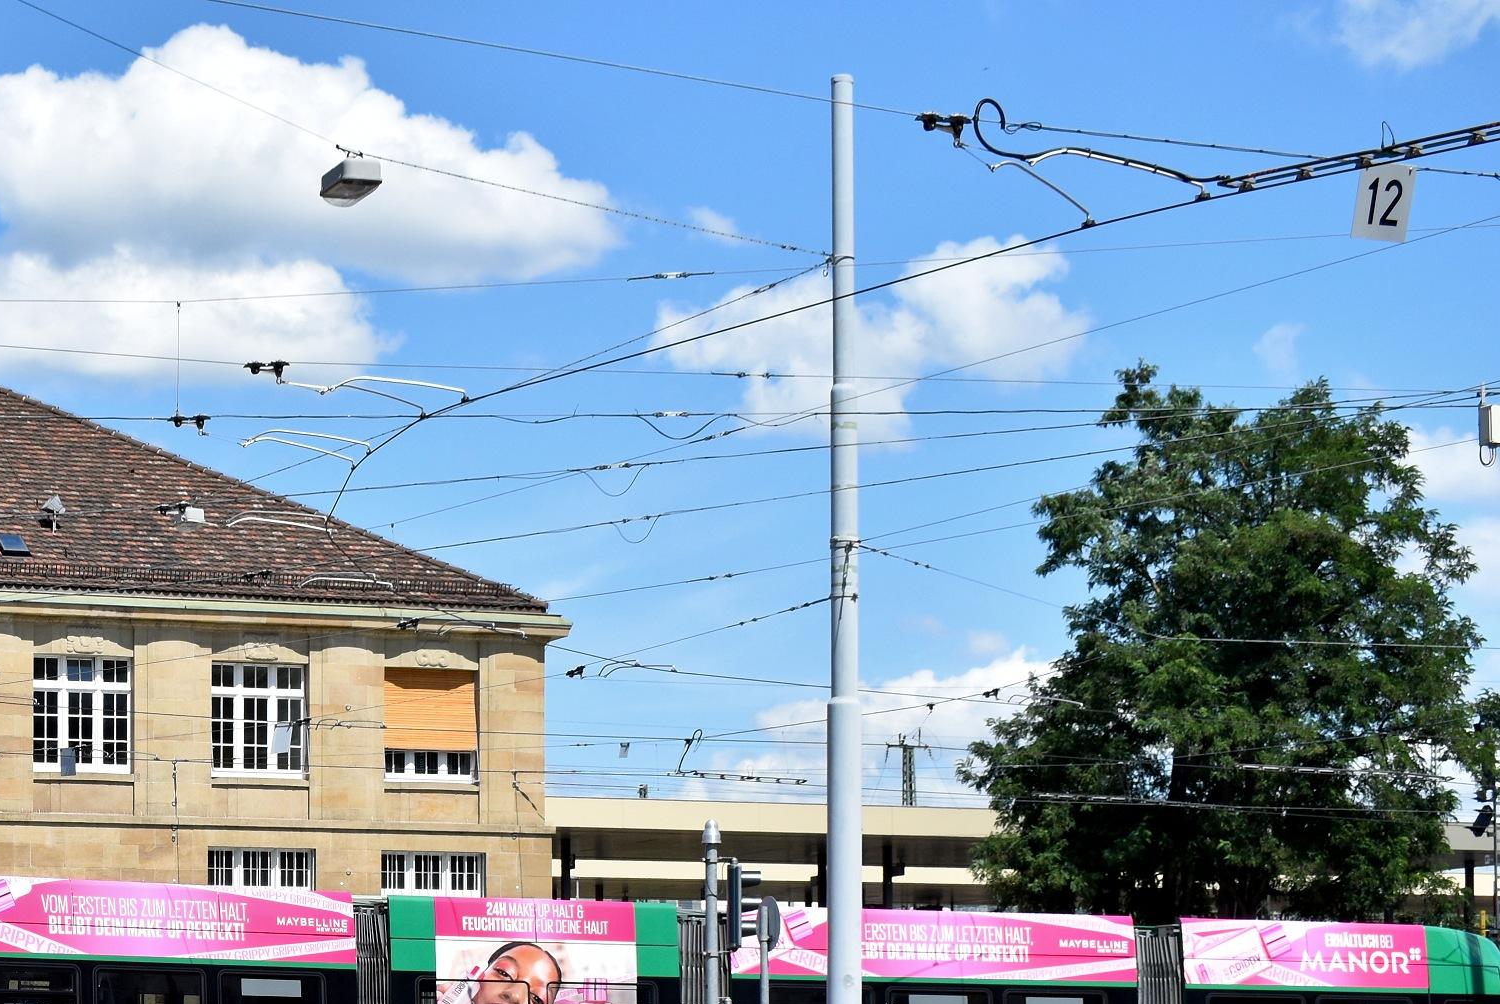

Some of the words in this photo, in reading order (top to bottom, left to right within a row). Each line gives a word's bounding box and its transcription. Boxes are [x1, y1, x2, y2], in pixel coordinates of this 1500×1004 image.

[1368, 177, 1403, 226] 12
[41, 894, 68, 914] VOM
[72, 896, 117, 916] ERSTEN
[119, 898, 138, 916] BIS
[140, 899, 165, 918] ZUM
[169, 901, 217, 920] LETZTEN
[220, 903, 250, 922] HALT,
[290, 894, 322, 906] GRIPPY
[486, 902, 507, 916] 24H
[552, 904, 574, 919] HALT
[577, 905, 584, 919] &
[48, 916, 93, 935] BLEIBT
[95, 917, 125, 936] DEIN
[187, 921, 245, 941] PERFEKT!
[276, 916, 348, 928] MAYBELLINE
[462, 916, 534, 932] FEUCHTIGKEIT
[536, 918, 554, 933] FÜR
[556, 920, 581, 934] DEINE
[584, 921, 608, 935] HAUT
[864, 923, 907, 942] ERSTEN
[909, 925, 928, 942] BIS
[930, 926, 954, 942] ZUM
[956, 926, 1001, 944] LETZTEN
[1005, 927, 1034, 945] HALT,
[1325, 931, 1379, 949] ERHÄLTLICH
[1380, 934, 1394, 949] BEI
[234, 949, 270, 960] GRIPPY
[272, 945, 303, 957] GRIPPY
[304, 942, 331, 954] GRIPPY
[861, 942, 885, 959] EIBT
[887, 943, 916, 960] DEIN
[973, 945, 1030, 962] PERFEKT!
[1060, 939, 1129, 950] MAYBELLINE
[788, 950, 827, 972] GRIP
[1301, 950, 1410, 974] MANOR
